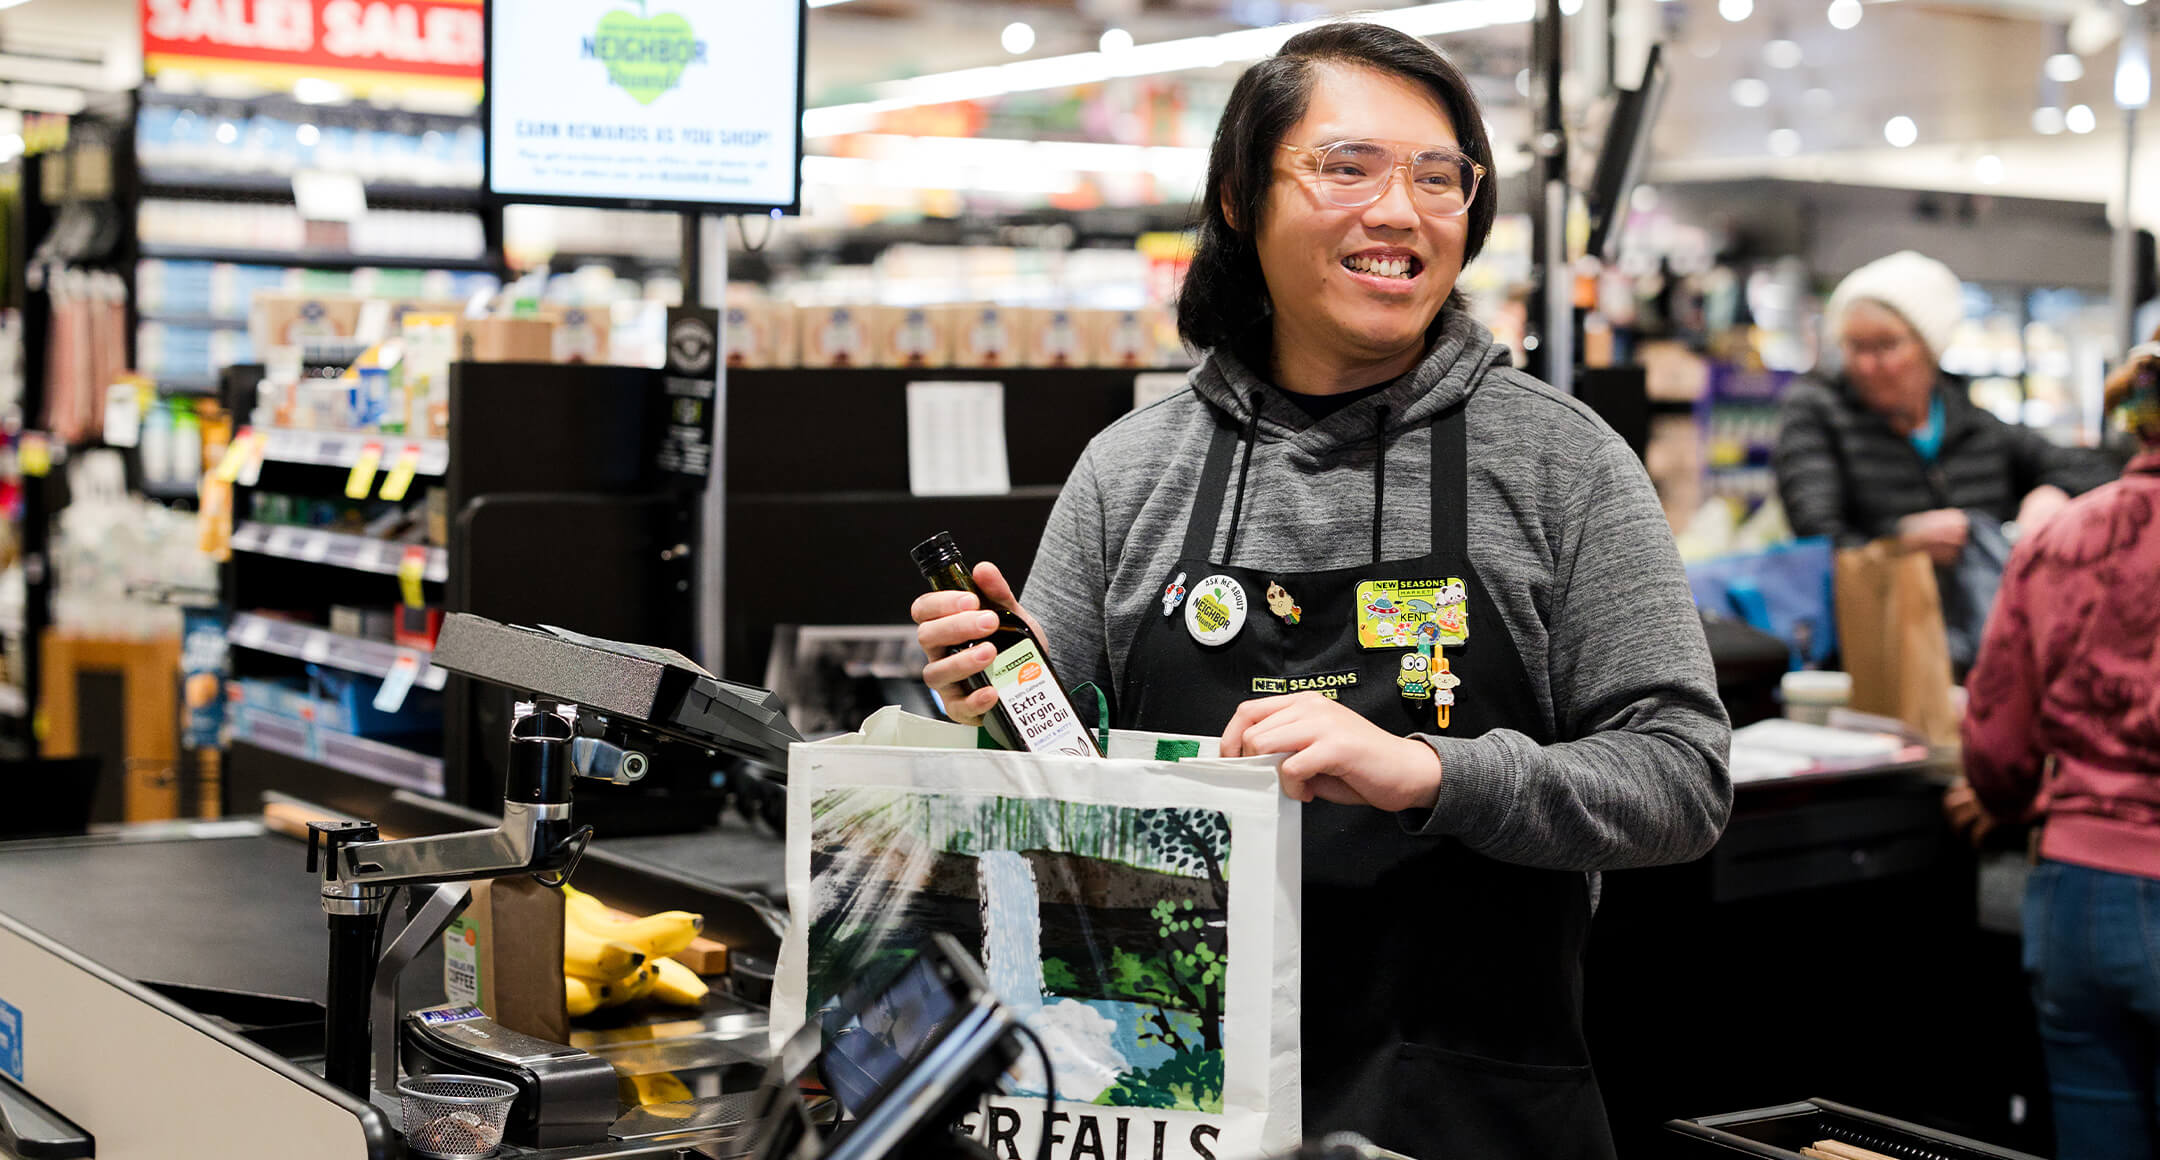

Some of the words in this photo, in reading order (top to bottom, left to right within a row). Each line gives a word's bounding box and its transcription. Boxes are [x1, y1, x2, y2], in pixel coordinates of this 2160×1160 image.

[148, 0, 314, 51] SALE!
[582, 36, 708, 64] NEIGHBOR
[516, 120, 561, 138] EARN
[568, 122, 648, 142] REWARDS
[682, 128, 712, 145] YOU
[1206, 577, 1218, 586] ASK
[1221, 578, 1232, 588] ME
[1231, 586, 1244, 611] ABOUT
[1400, 579, 1446, 588] SEASONS
[1193, 598, 1230, 630] NEIGHBOR
[1401, 613, 1427, 622] KENT
[1255, 680, 1286, 691] NEW
[1290, 673, 1357, 690] SEASONS
[1012, 691, 1046, 714] Extra
[1019, 702, 1056, 726] Virgin
[1026, 719, 1053, 738] Olive
[1053, 708, 1069, 722] Oil
